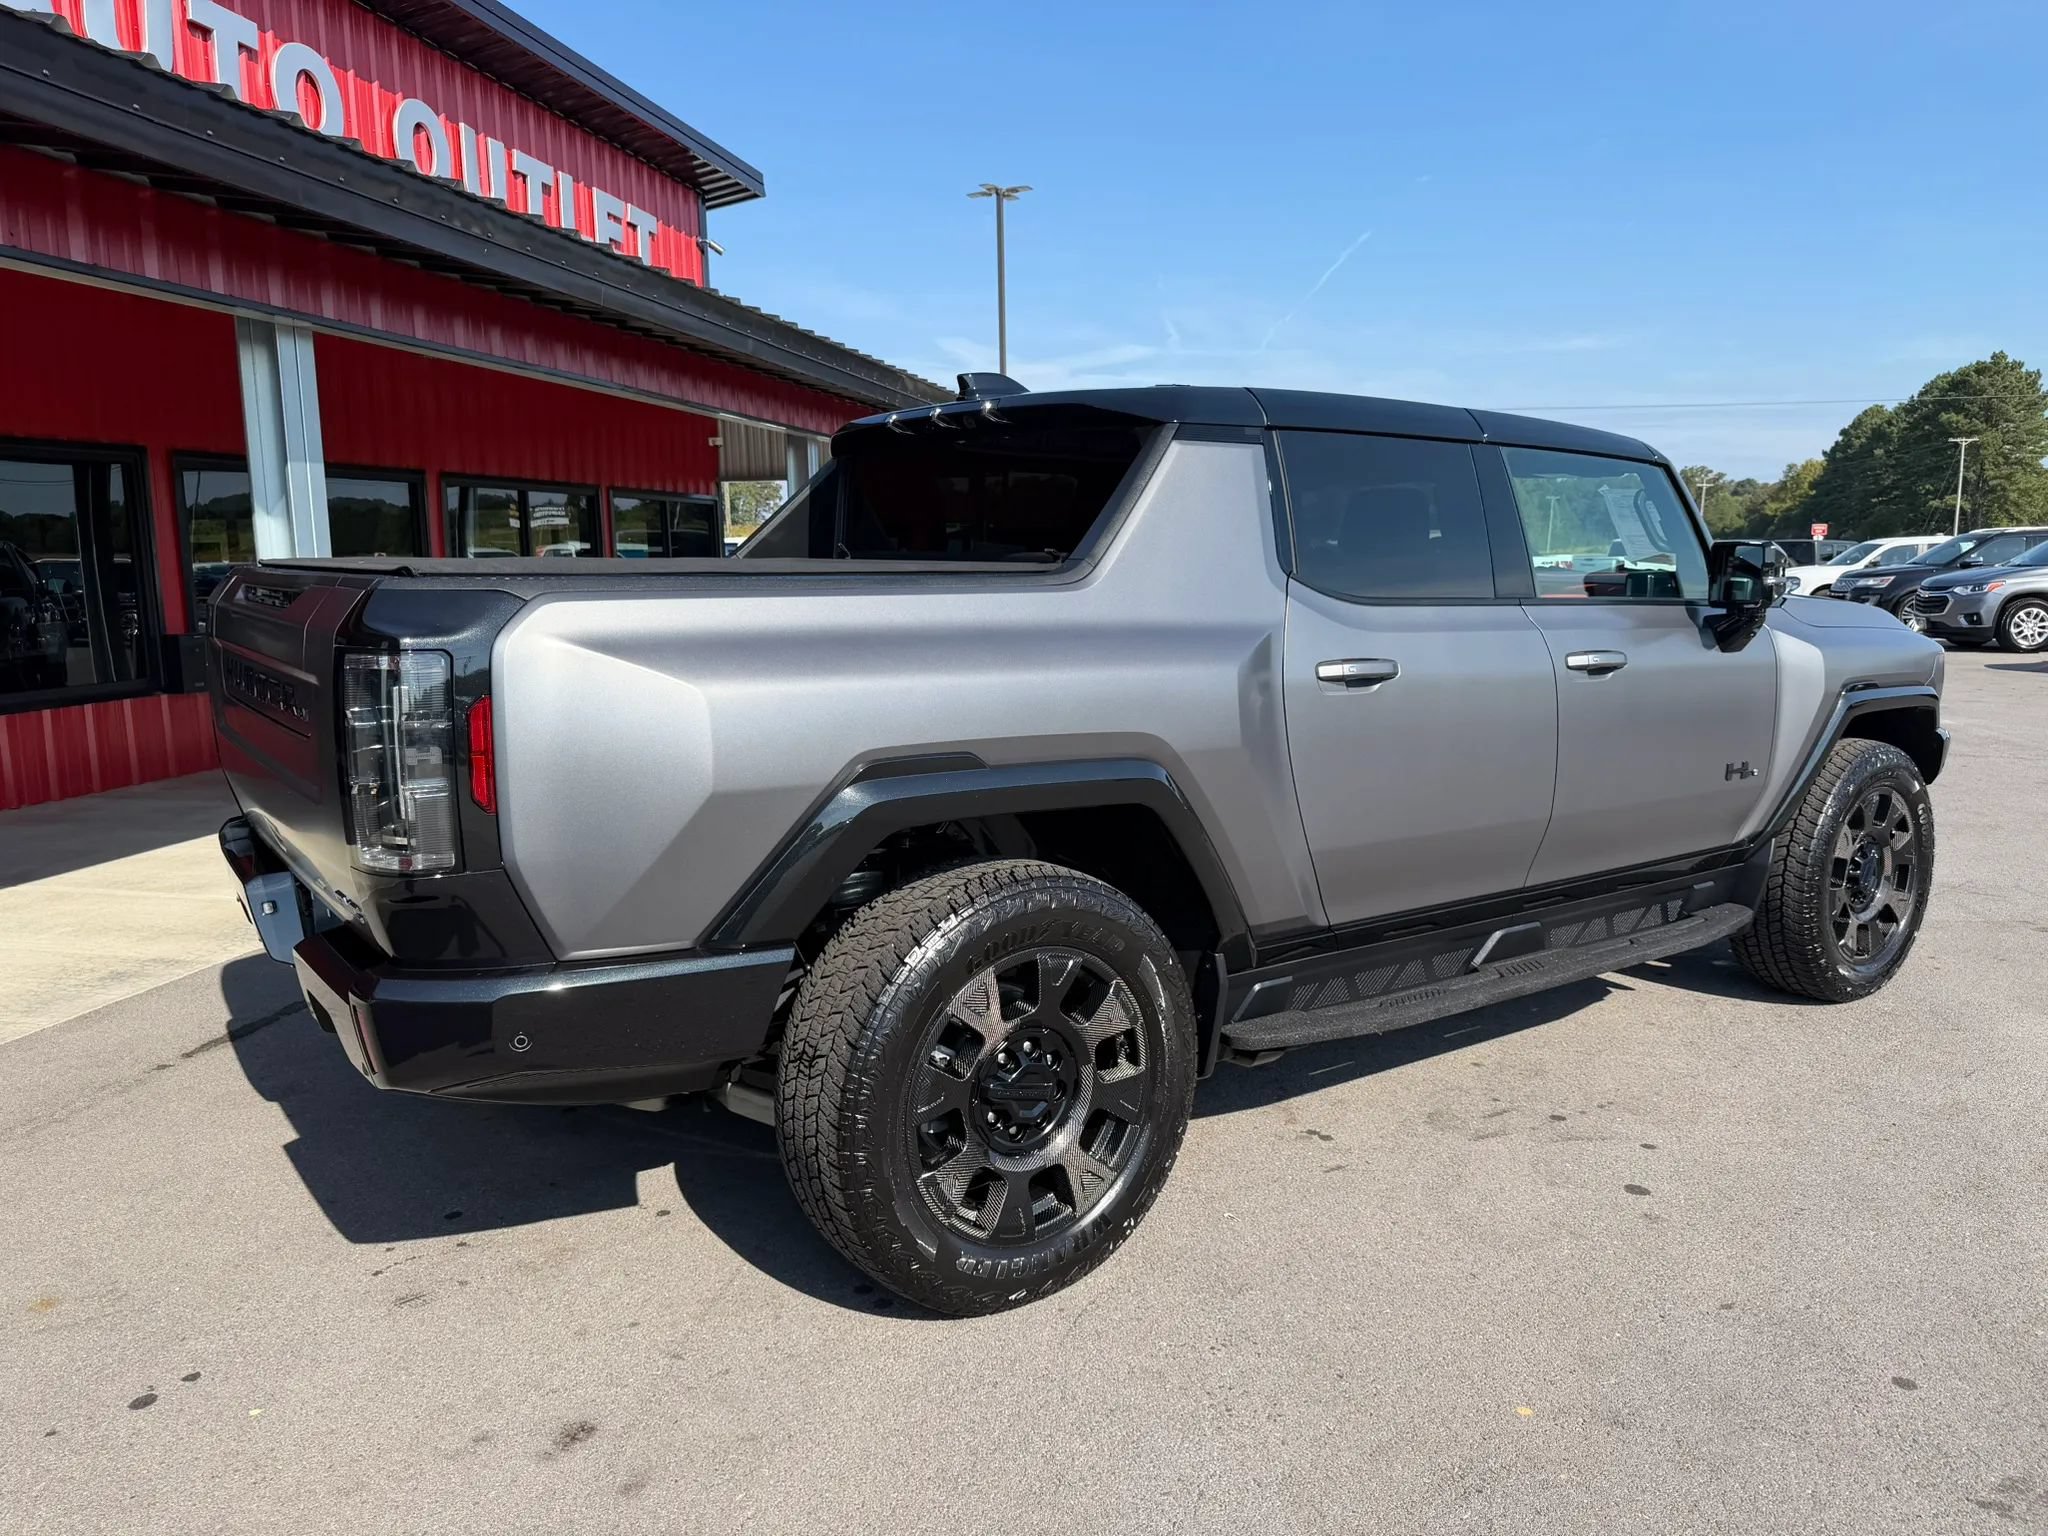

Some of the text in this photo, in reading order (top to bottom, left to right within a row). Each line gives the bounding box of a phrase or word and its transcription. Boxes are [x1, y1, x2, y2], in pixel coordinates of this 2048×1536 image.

[0, 0, 658, 266] UTO OUTLET
[966, 919, 1126, 974] GOODYEAR
[956, 1212, 1113, 1280] WRANGLER
